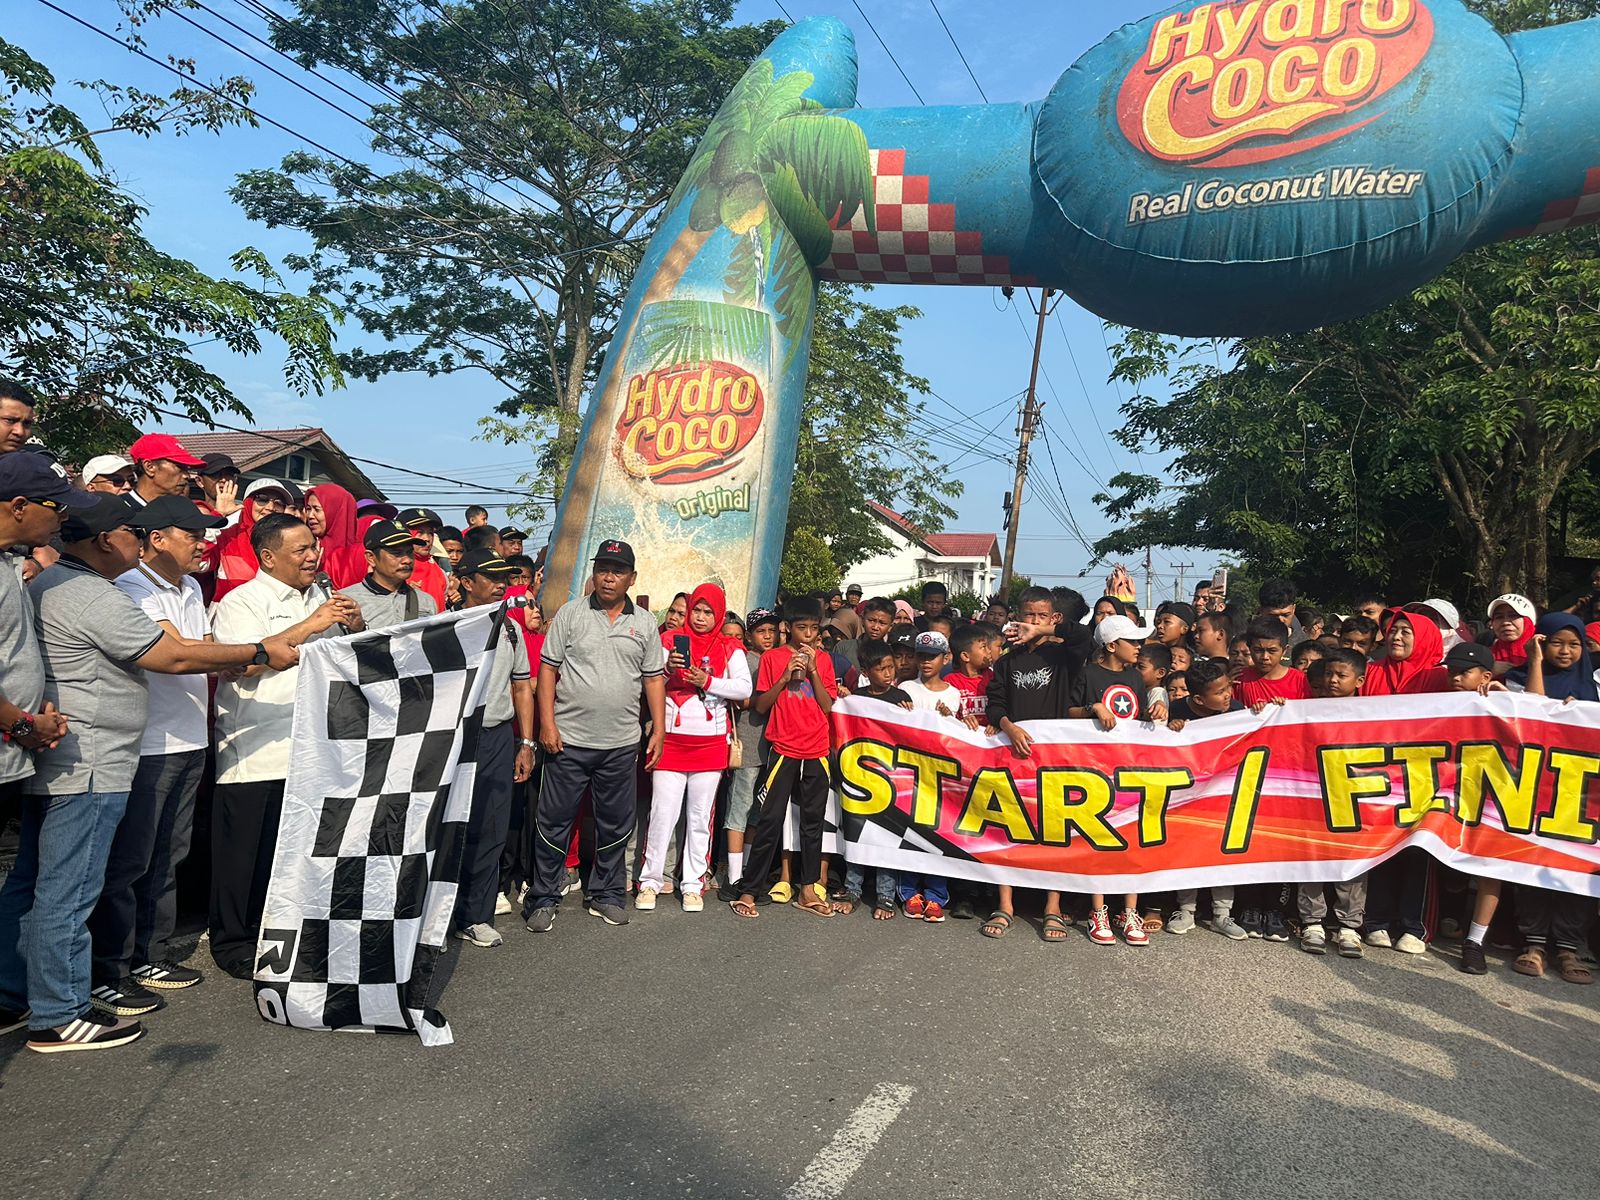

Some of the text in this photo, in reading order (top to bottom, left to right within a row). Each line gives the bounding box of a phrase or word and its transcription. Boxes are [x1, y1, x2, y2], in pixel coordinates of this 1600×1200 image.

[1128, 166, 1422, 223] Real Coconut Water
[625, 368, 757, 421] Hydro
[837, 738, 1600, 853] START / FINI
